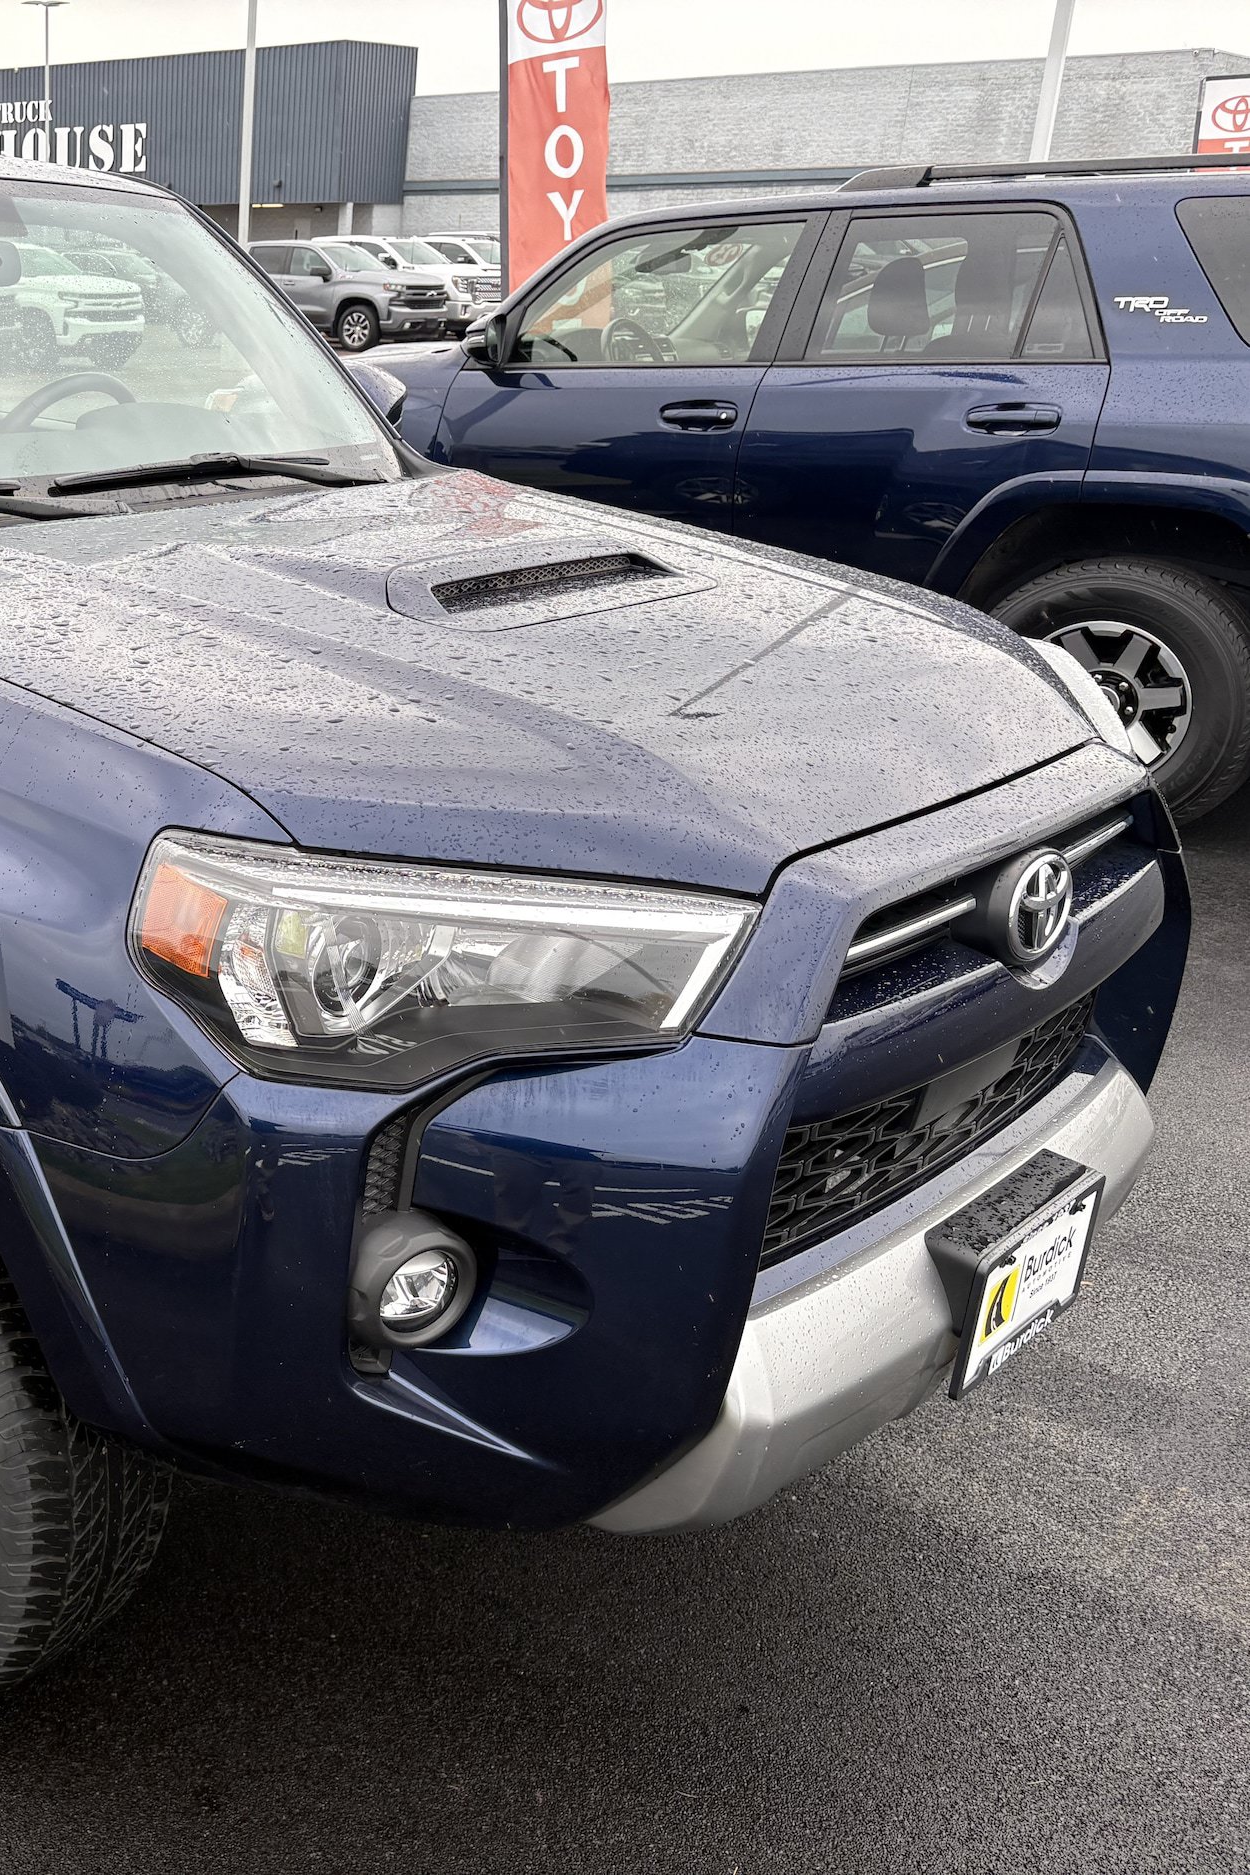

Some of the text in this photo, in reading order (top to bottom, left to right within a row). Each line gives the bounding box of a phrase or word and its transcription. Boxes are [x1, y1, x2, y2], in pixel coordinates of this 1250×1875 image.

[1113, 296, 1170, 313] TRD
[1024, 1226, 1077, 1283] Burdick
[1002, 1309, 1055, 1363] Burdick
